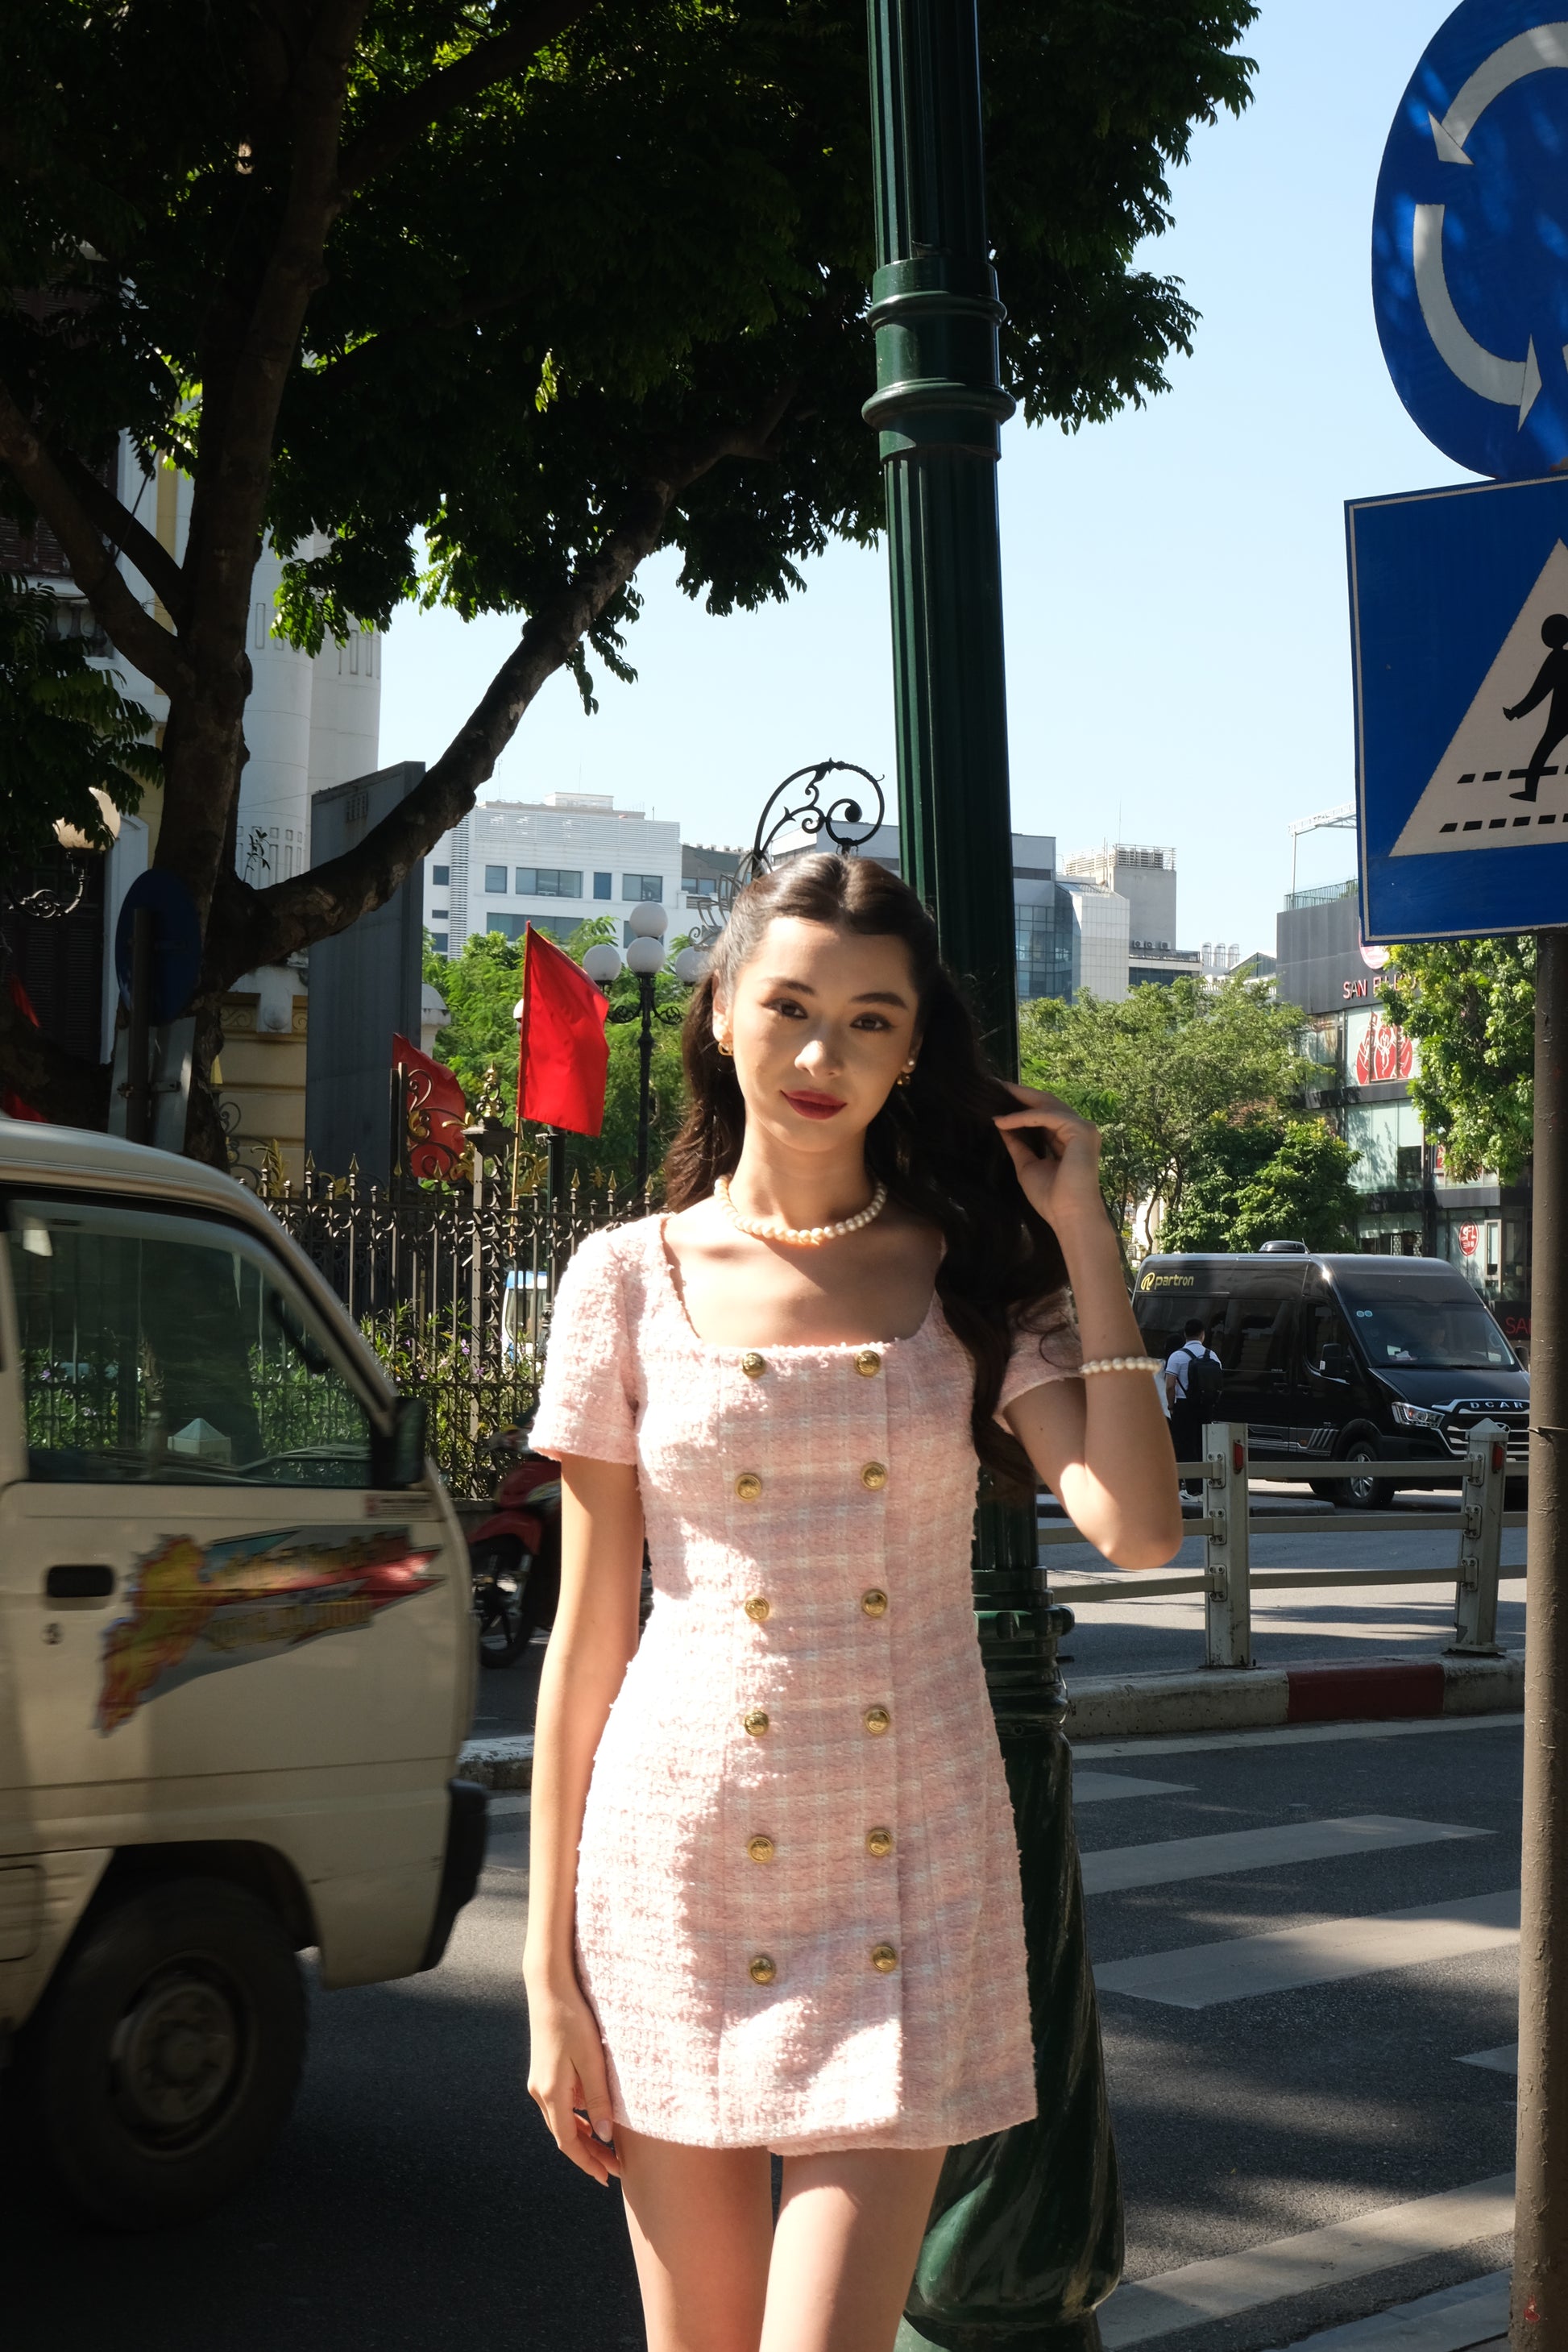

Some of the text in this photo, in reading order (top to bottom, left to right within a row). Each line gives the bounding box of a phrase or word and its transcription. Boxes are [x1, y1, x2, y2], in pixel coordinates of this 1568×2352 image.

[1343, 979, 1367, 999] SAN
[1155, 1274, 1194, 1290] partron
[1505, 1317, 1532, 1334] SA
